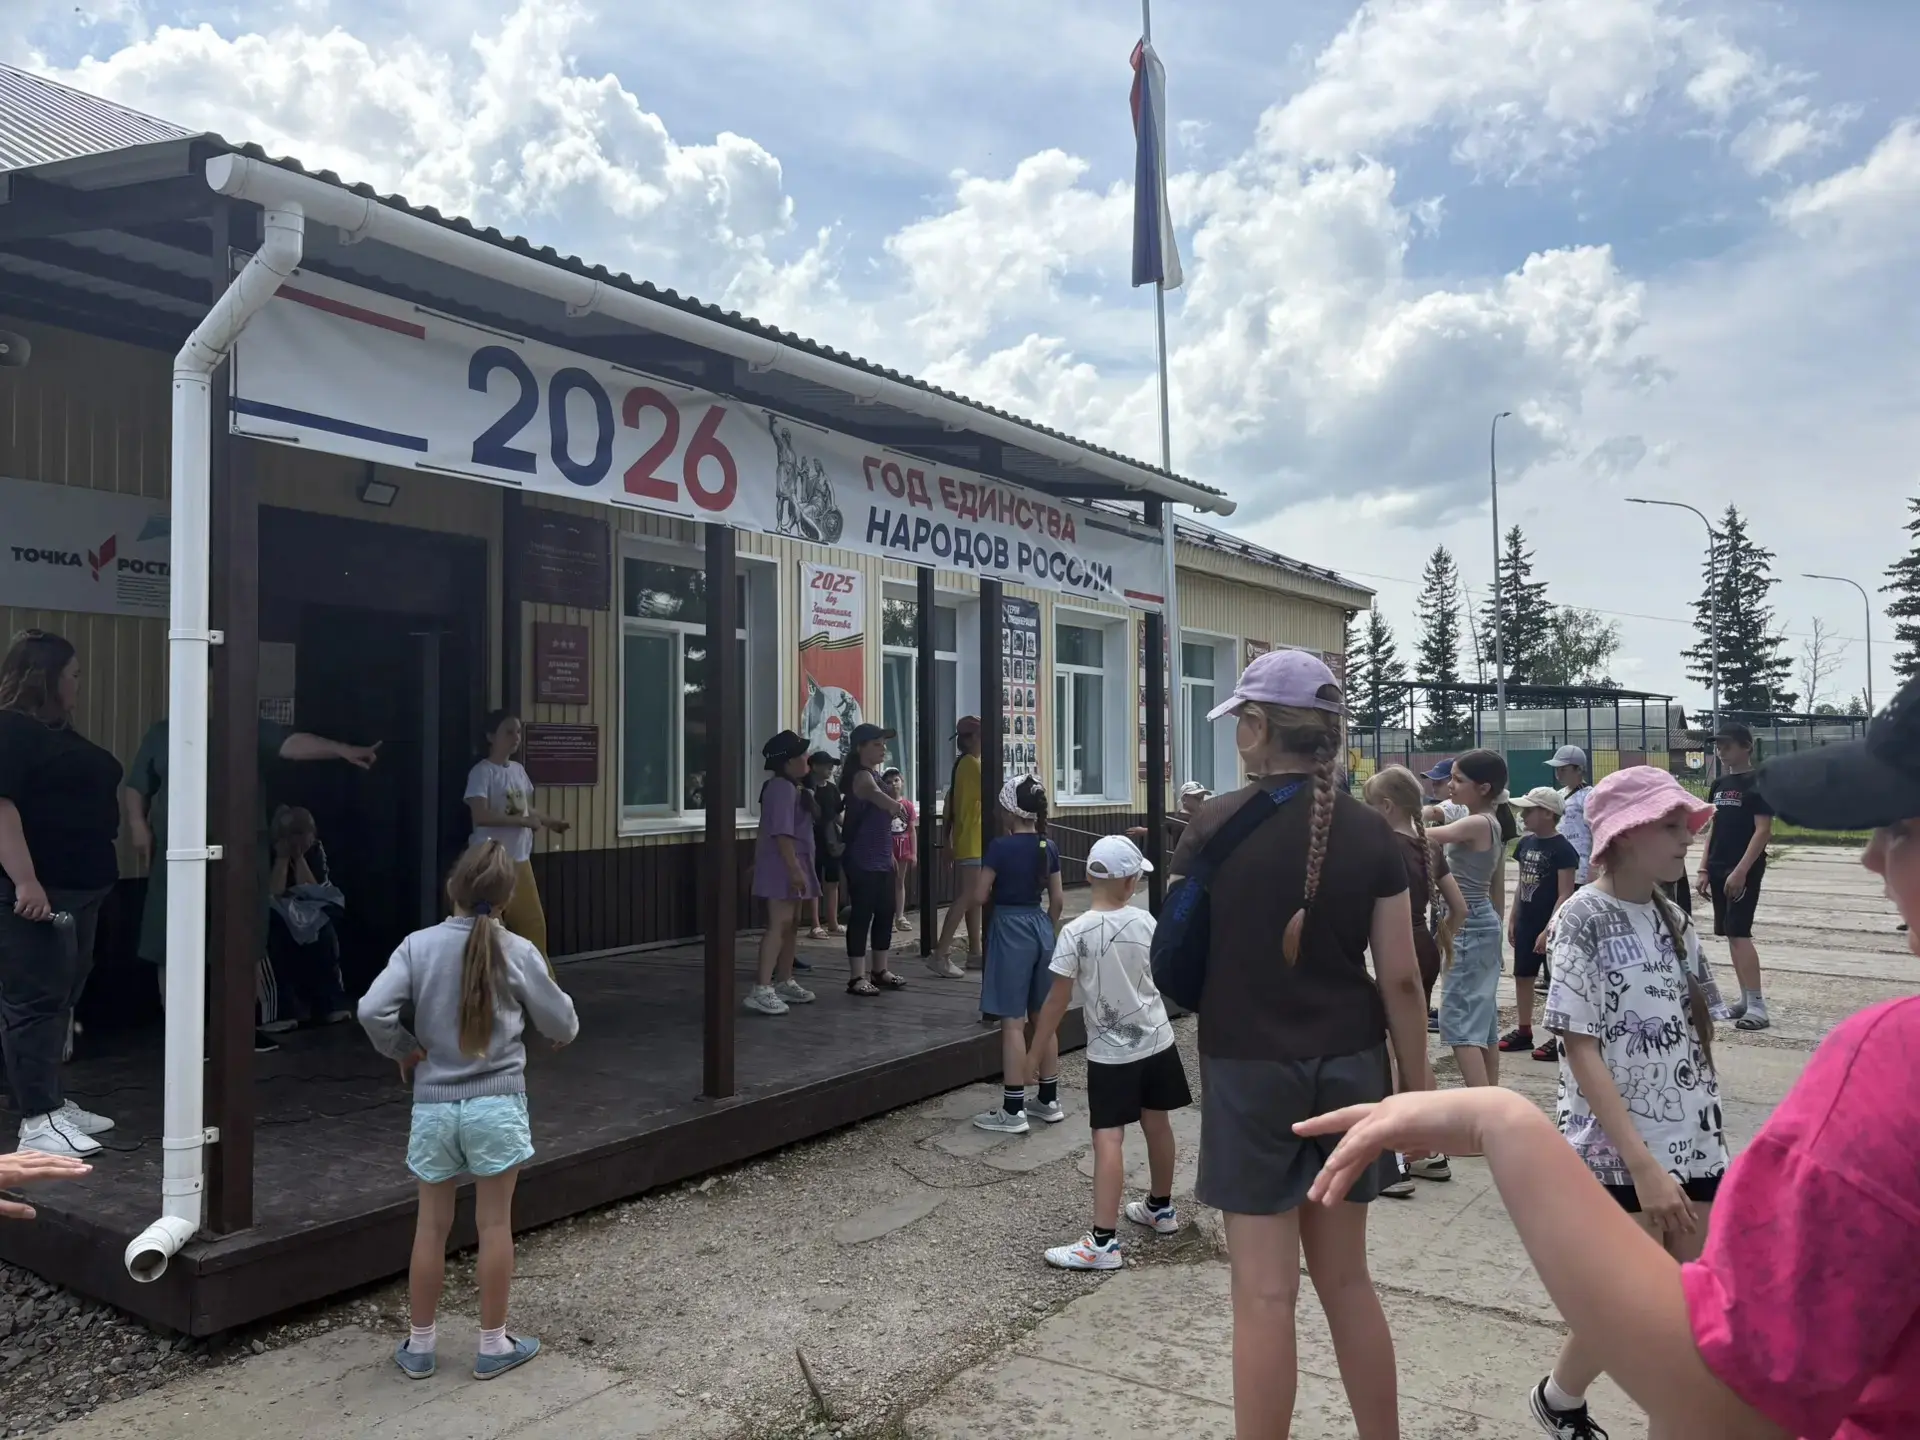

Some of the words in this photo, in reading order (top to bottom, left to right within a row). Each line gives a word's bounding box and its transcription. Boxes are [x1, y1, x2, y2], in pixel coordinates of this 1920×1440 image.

[468, 345, 738, 513] 2026
[862, 455, 933, 511] ГОД
[939, 476, 1076, 544] ЕДИНСТВА
[11, 546, 82, 567] ТОЧКА
[865, 506, 1010, 569] НАРОДОВ
[1017, 541, 1113, 595] РОССИИ
[810, 570, 856, 594] 2025
[812, 602, 852, 618] Защитника
[825, 592, 838, 606] Год
[812, 615, 852, 629] Отечества
